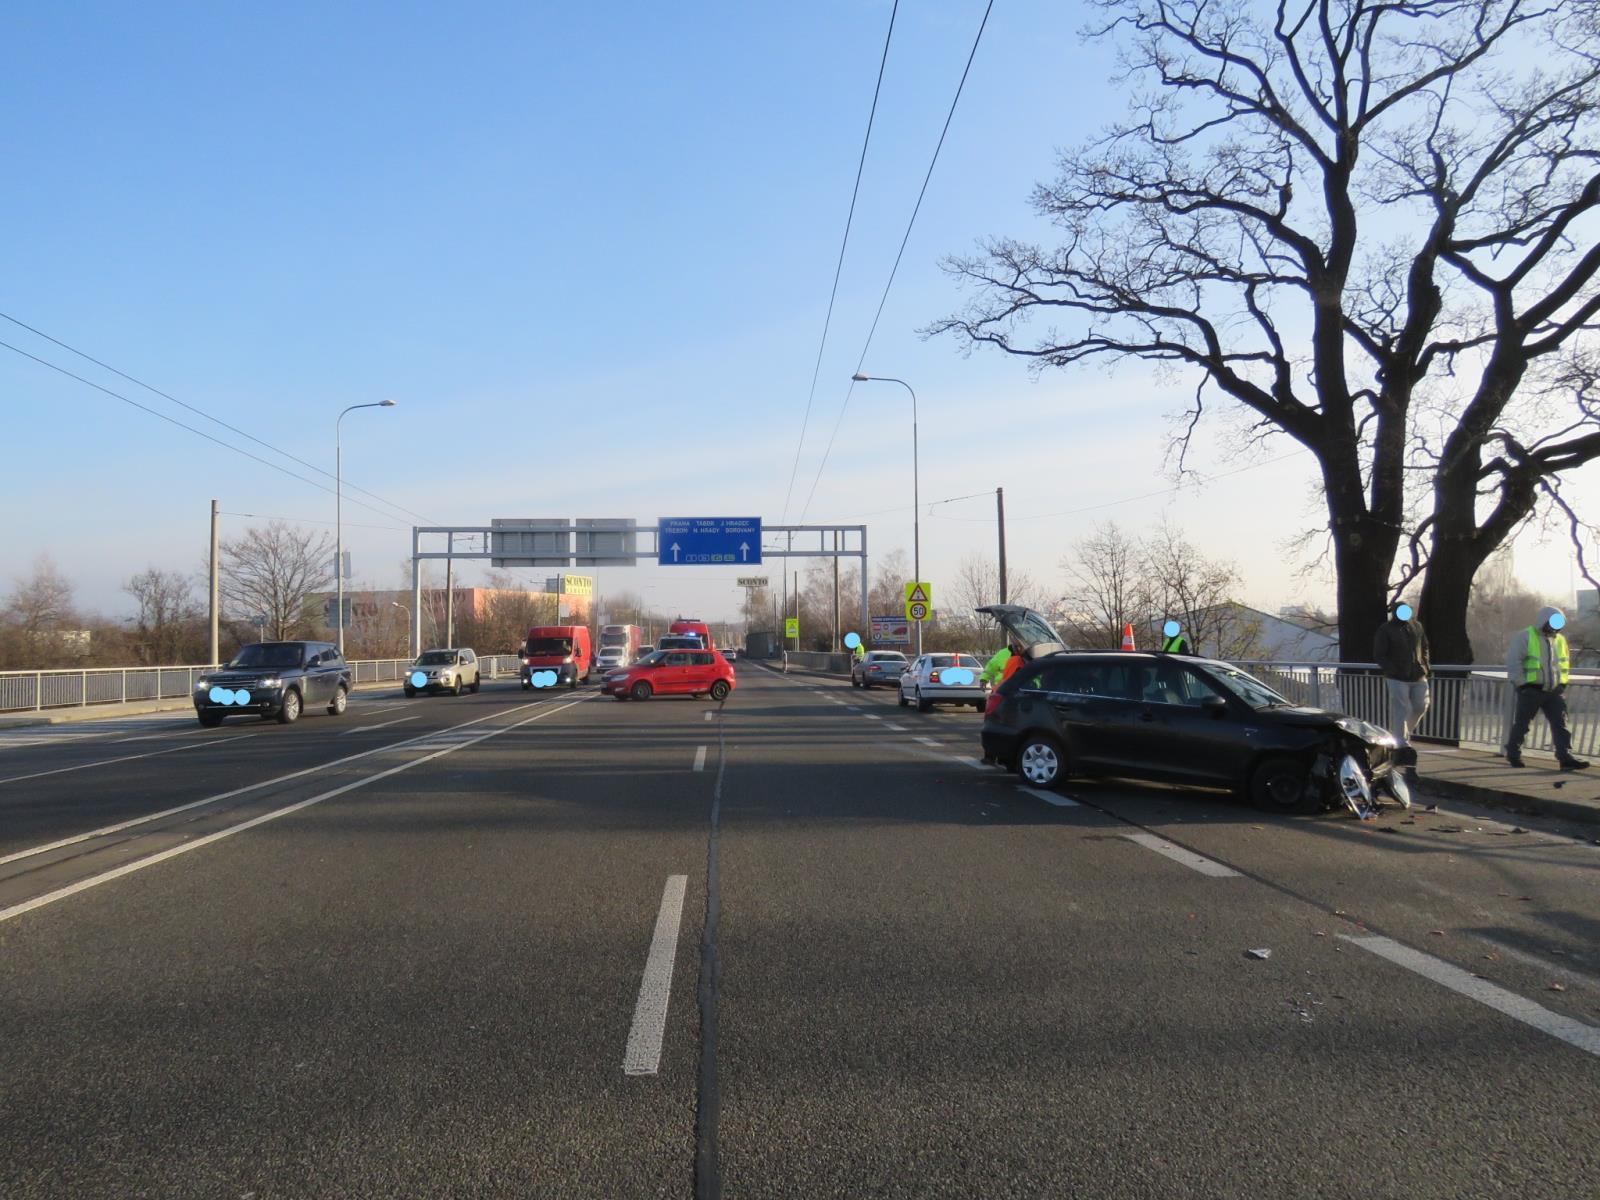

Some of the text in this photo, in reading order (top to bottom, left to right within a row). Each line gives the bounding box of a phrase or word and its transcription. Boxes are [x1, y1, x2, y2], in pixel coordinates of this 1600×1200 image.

[566, 576, 592, 587] SCONTO
[737, 577, 768, 586] SCONTO
[913, 606, 924, 616] 50
